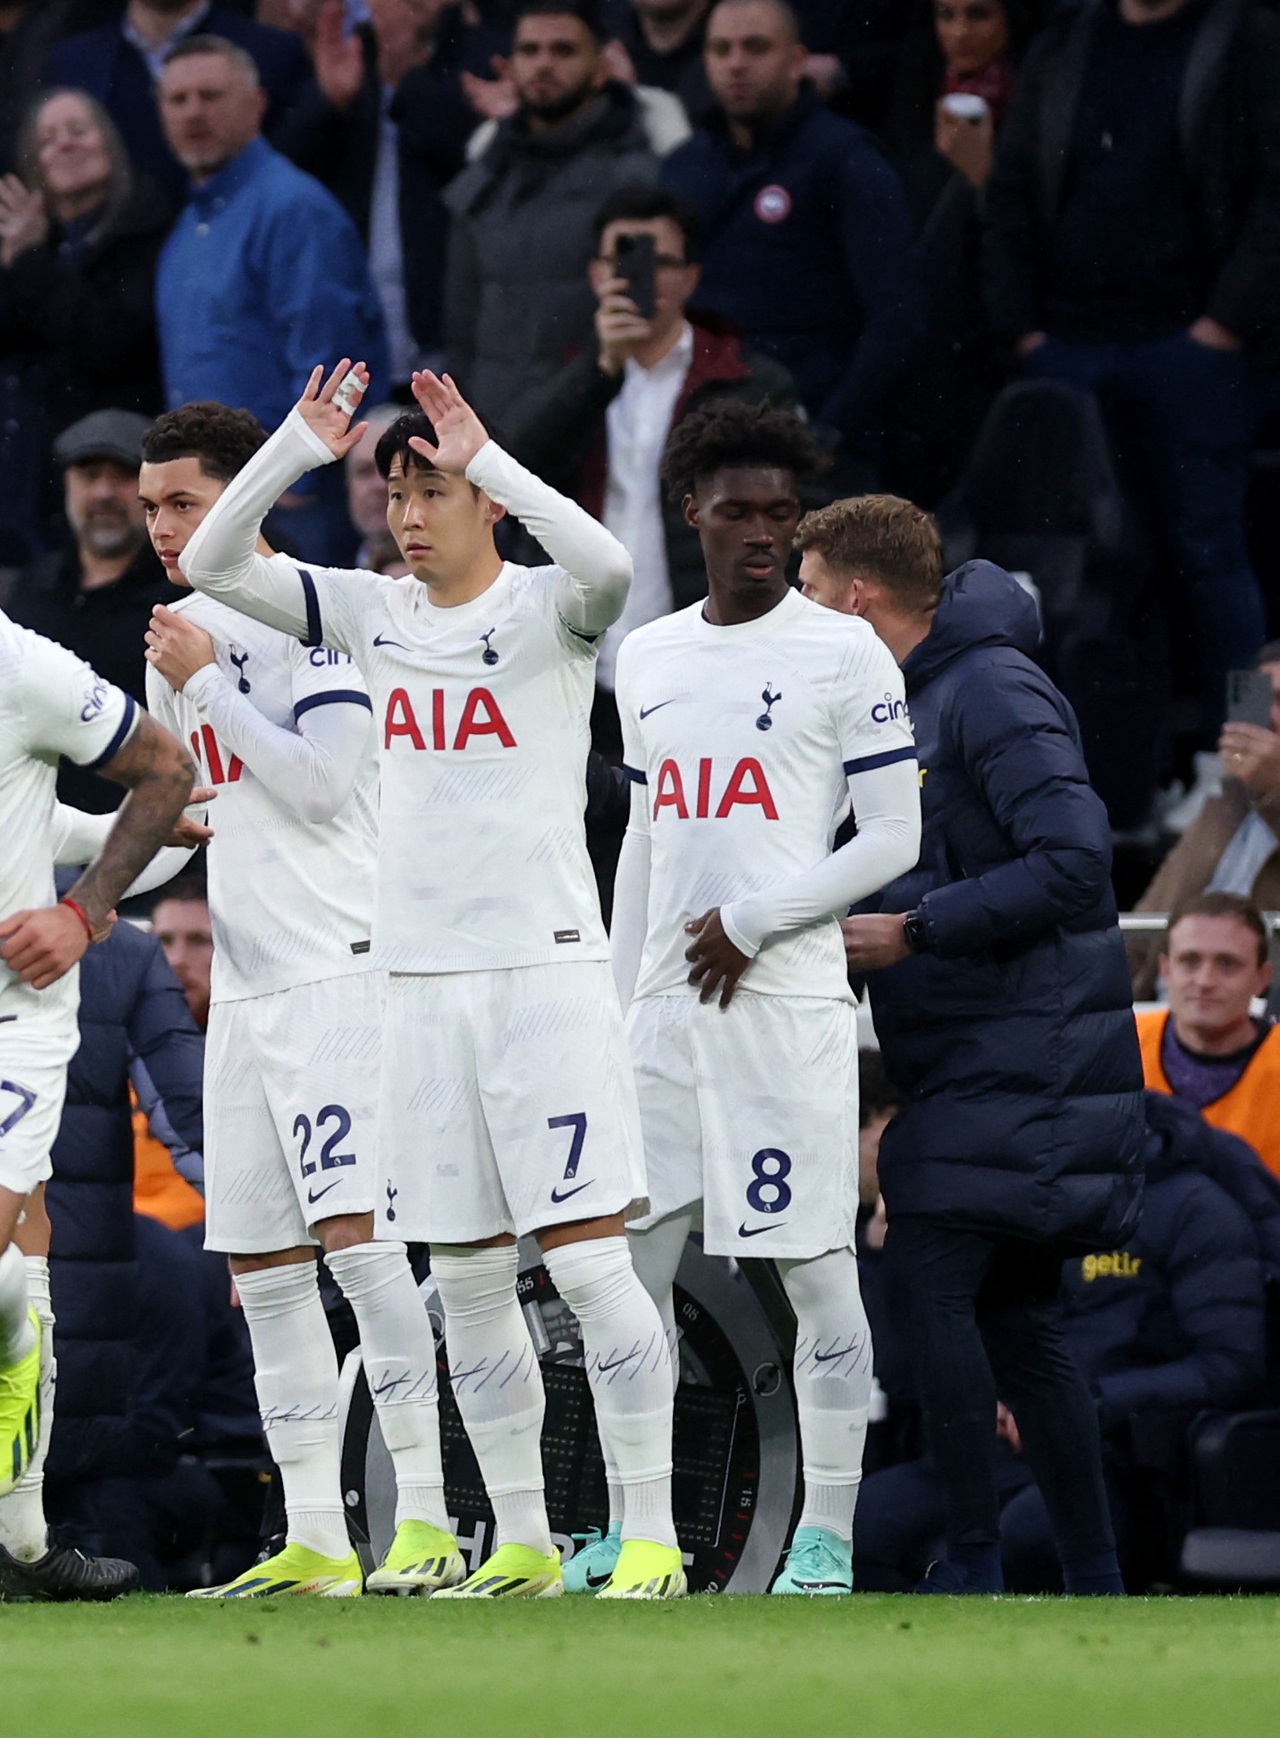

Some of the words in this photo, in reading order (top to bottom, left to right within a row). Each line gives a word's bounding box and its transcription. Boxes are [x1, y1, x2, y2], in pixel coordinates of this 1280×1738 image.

[384, 687, 518, 750] AIA
[653, 757, 780, 822] AIA
[293, 1104, 356, 1179] 22
[547, 1112, 587, 1180] 7
[746, 1147, 792, 1213] 8
